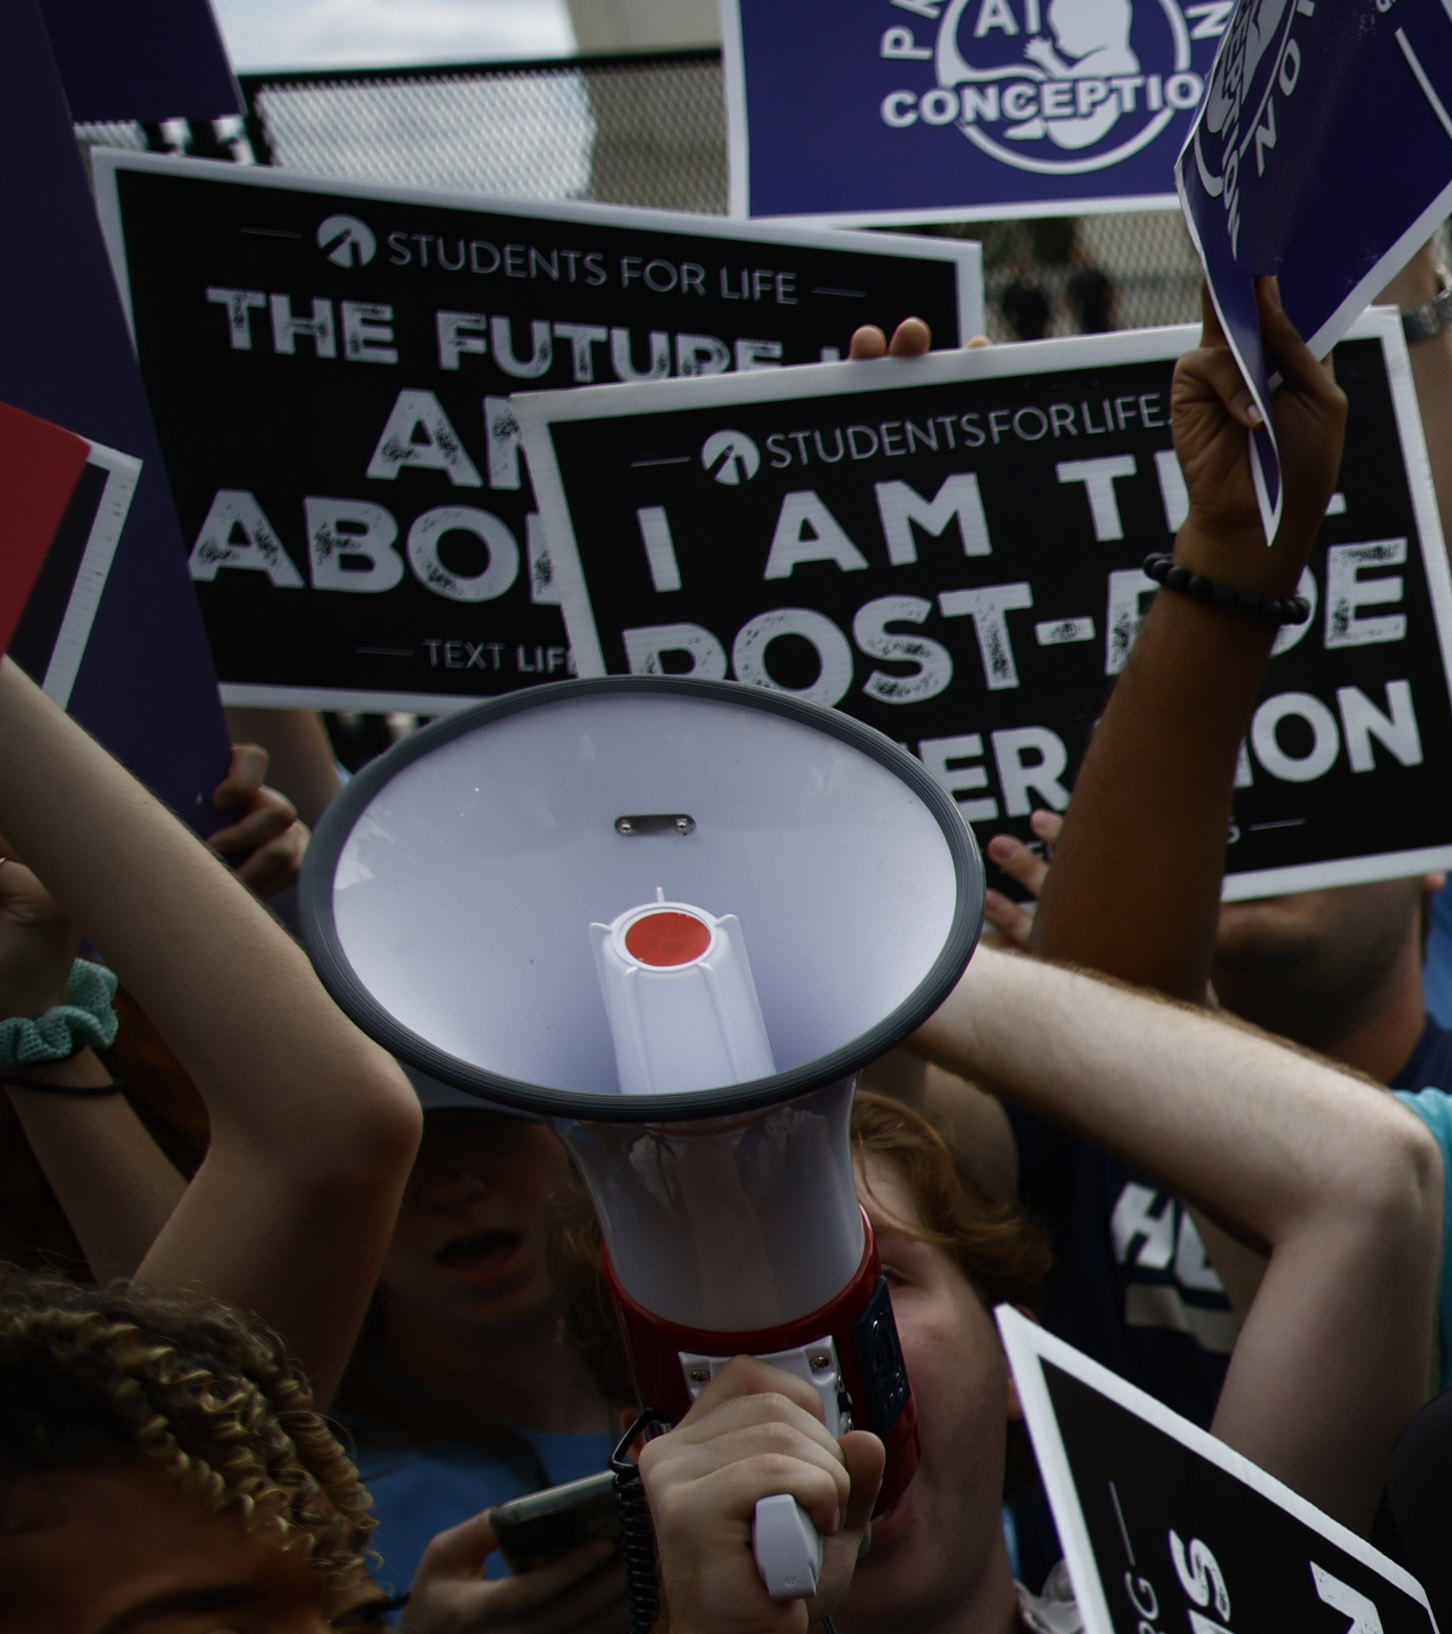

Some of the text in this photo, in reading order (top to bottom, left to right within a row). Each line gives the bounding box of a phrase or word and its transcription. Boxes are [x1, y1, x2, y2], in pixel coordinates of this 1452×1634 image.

[388, 232, 799, 305] STUDENTS FOR LIFE
[206, 287, 399, 365] THE
[637, 505, 682, 592] I
[763, 471, 993, 580] AM
[423, 638, 504, 671] TEXT
